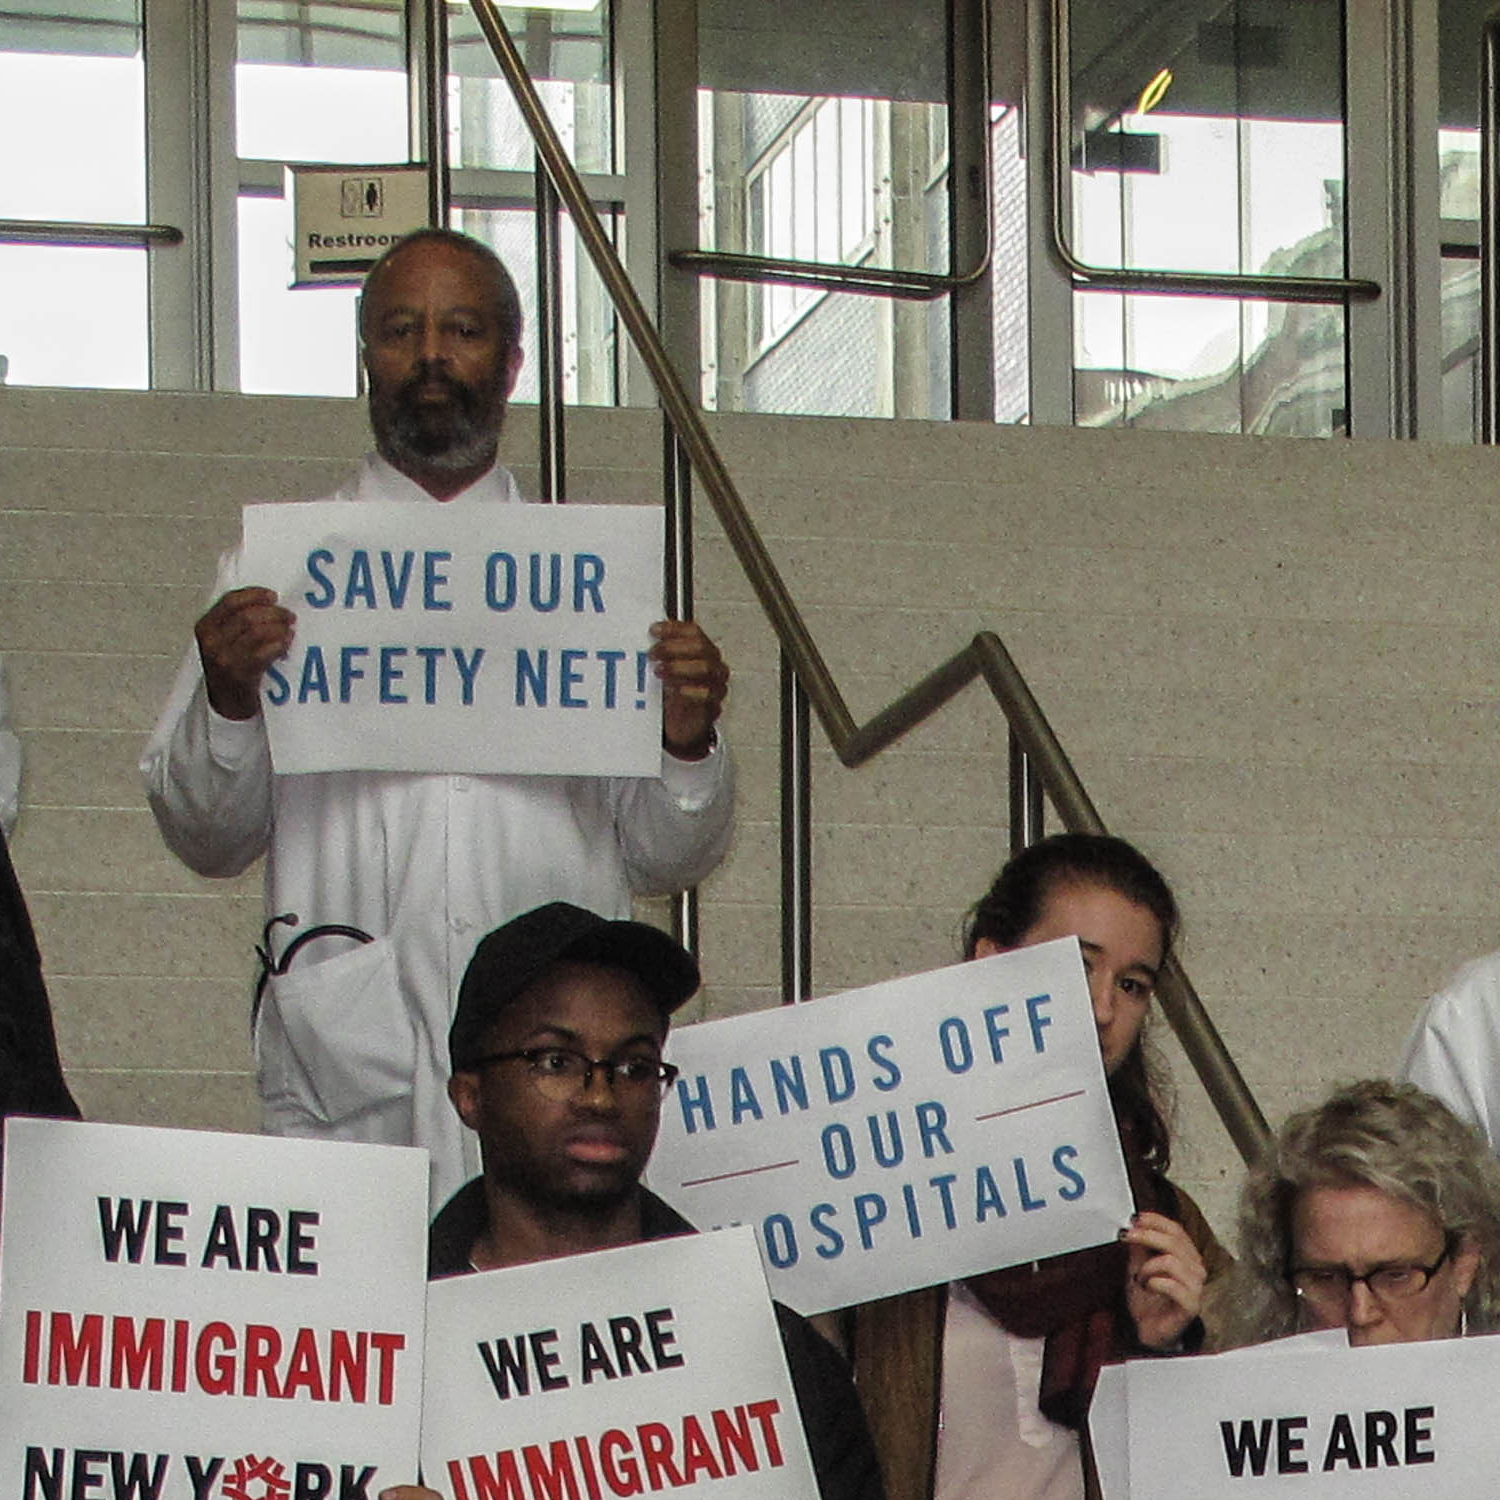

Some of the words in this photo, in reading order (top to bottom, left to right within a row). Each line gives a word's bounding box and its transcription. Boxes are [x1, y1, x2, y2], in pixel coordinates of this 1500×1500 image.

[304, 549, 453, 612] SAVE
[485, 552, 606, 614] OUR
[515, 649, 649, 709] NET!
[676, 1034, 901, 1135] HANDS
[938, 994, 1052, 1074] OFF
[821, 1101, 955, 1180] OUR
[98, 1197, 190, 1266] WE
[201, 1207, 320, 1275] ARE
[714, 1145, 1087, 1270] OSPITALS
[21, 1310, 406, 1406] IMMIGRANT
[479, 1329, 568, 1400] WE
[580, 1308, 686, 1383] ARE
[1219, 1417, 1308, 1477] WE
[1322, 1406, 1435, 1471] ARE
